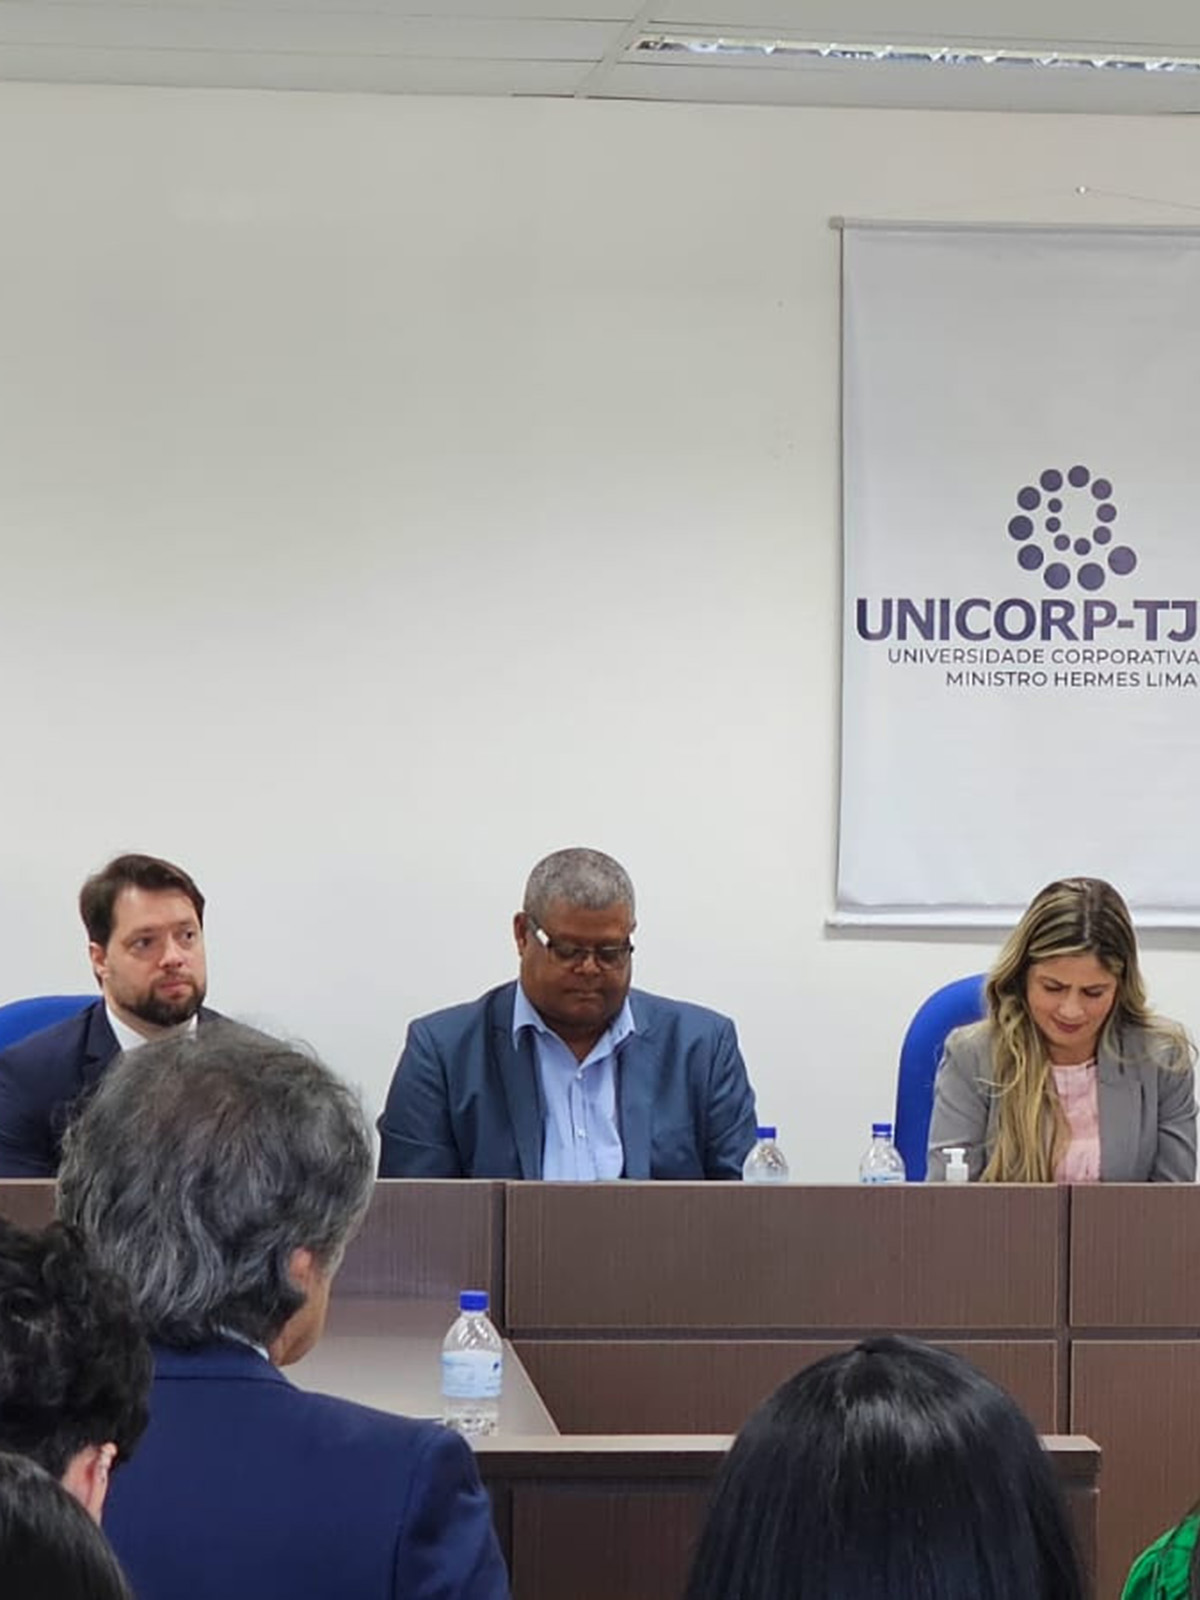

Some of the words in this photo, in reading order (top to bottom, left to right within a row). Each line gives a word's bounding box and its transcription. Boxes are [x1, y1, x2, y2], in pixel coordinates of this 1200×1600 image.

[887, 648, 1045, 665] UNIVERSIDADE
[1051, 648, 1200, 666] CORPORATIVA
[946, 671, 1048, 688] MINISTRO
[1053, 671, 1141, 688] HERMES
[1146, 672, 1198, 688] LIMA
